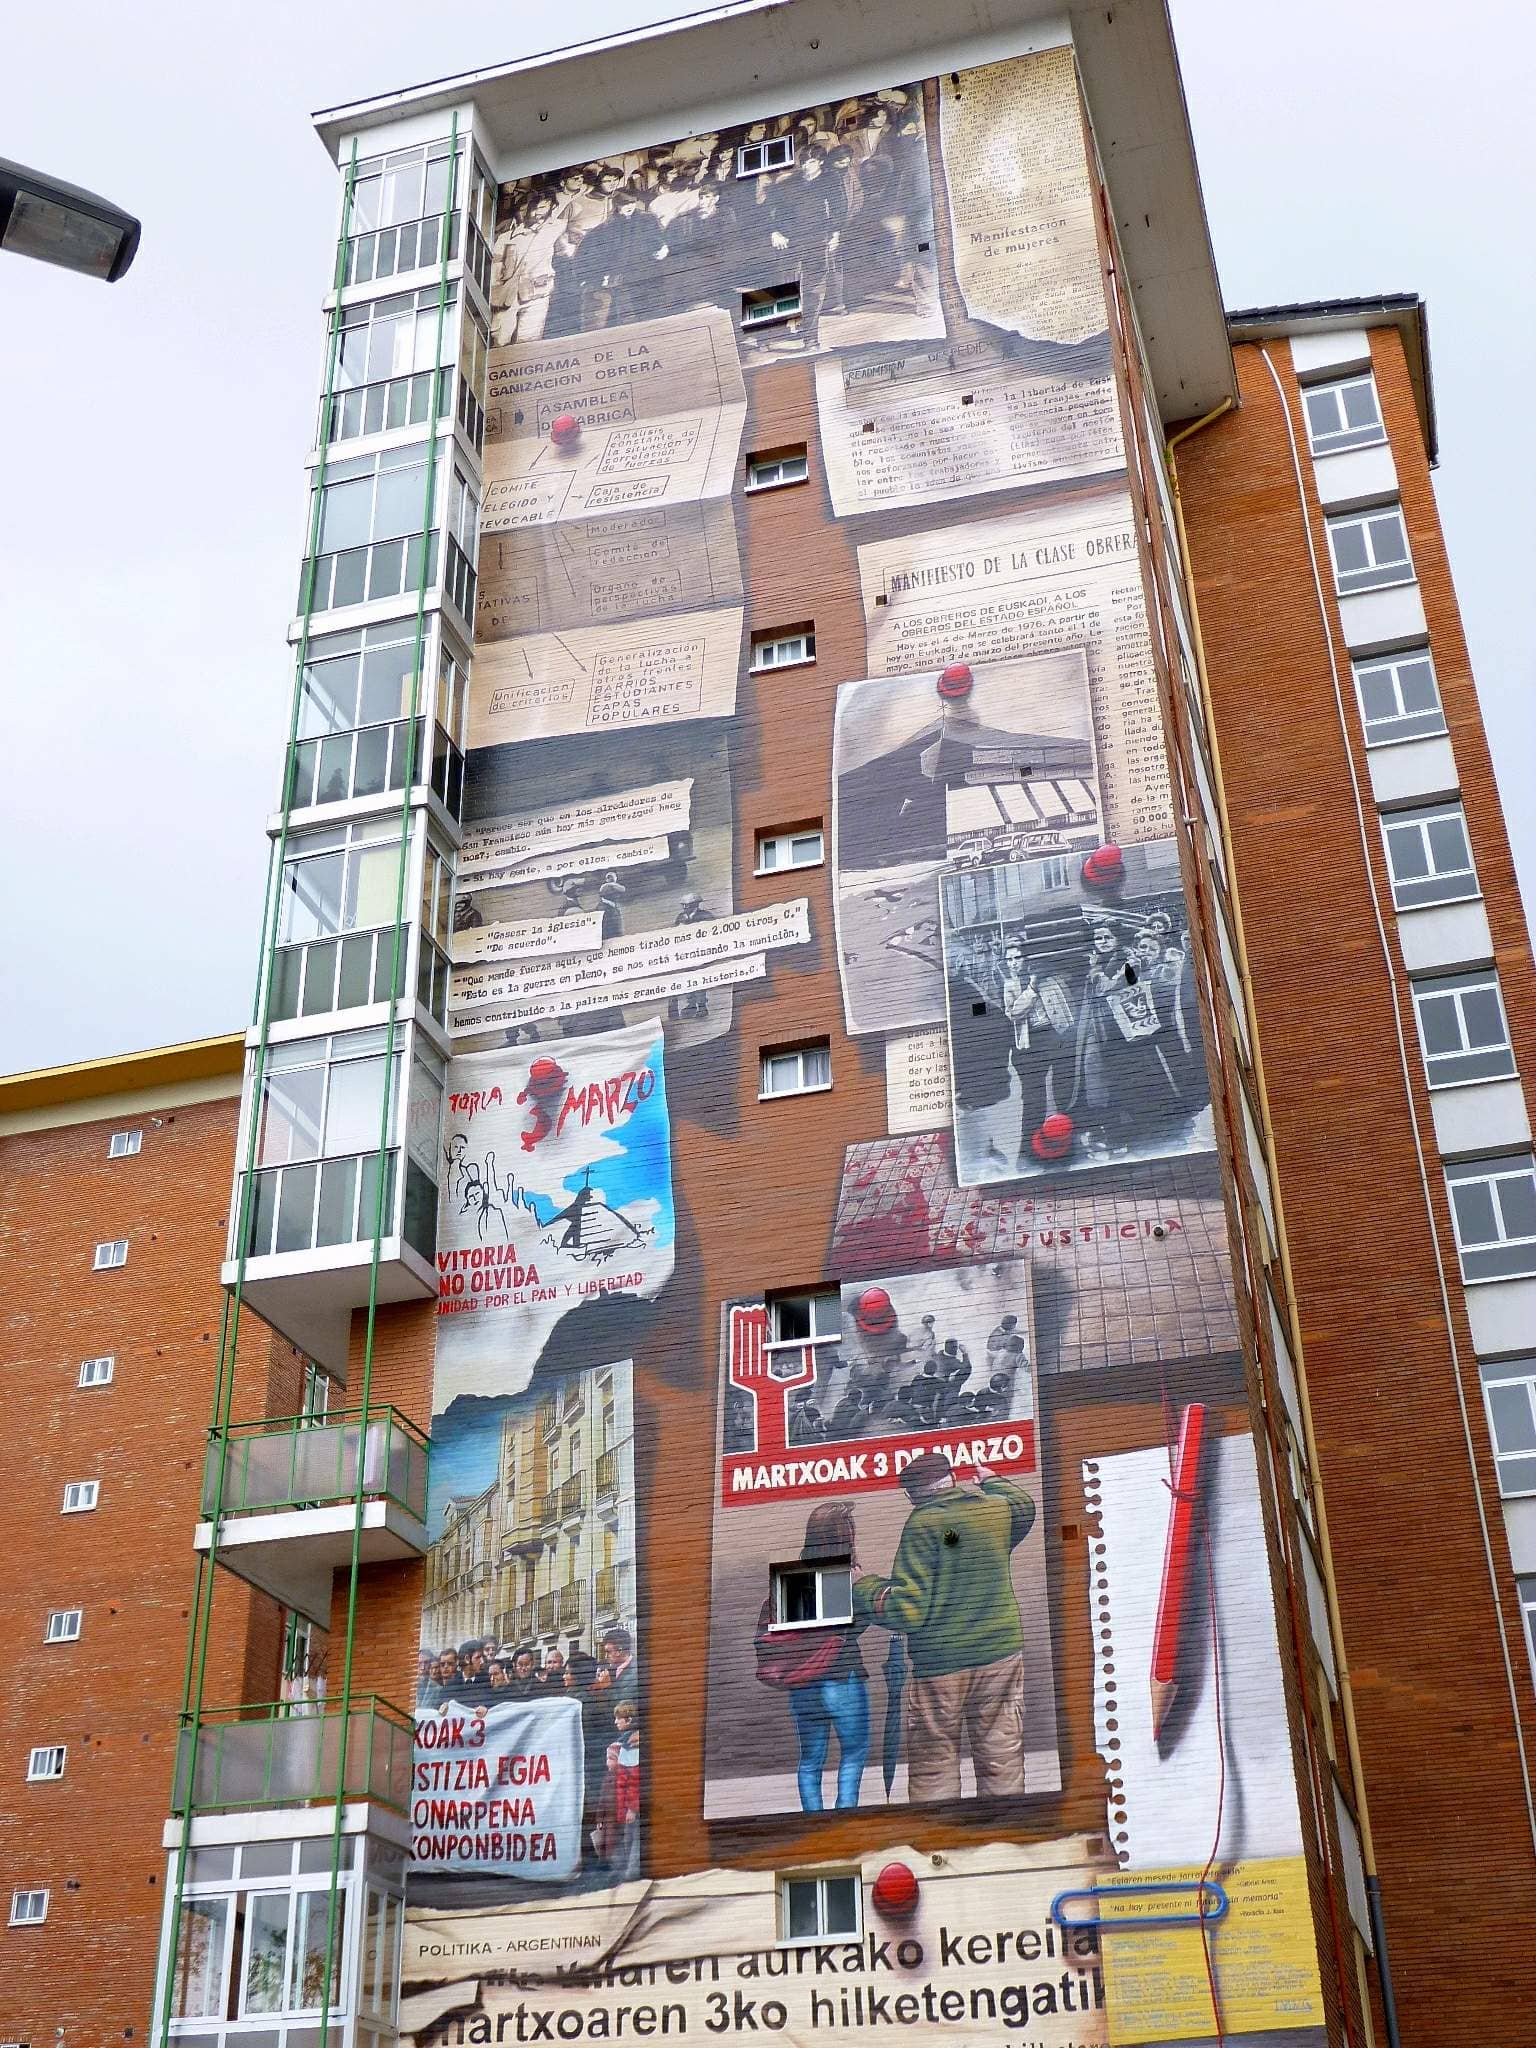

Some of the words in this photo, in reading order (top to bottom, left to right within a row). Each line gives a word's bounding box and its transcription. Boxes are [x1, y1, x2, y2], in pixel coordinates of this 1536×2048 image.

[970, 218, 1066, 245] Manifestación
[984, 245, 1001, 257] de
[1006, 236, 1059, 254] mujeres
[594, 351, 613, 363] DE
[628, 345, 649, 358] LA
[595, 359, 663, 380] OBRERA
[540, 391, 629, 415] ASAMBLEA
[577, 407, 633, 426] ABRICA
[594, 487, 620, 497] Caja
[484, 497, 537, 513] ELEGIDO
[891, 561, 975, 593] MANIFIESTO
[984, 555, 1002, 575] DE
[1011, 551, 1028, 570] LA
[1036, 543, 1076, 566] CLASE
[903, 619, 923, 628] LOS
[925, 609, 977, 625] OBREROS
[980, 606, 995, 616] DE
[1055, 594, 1062, 602] A
[1065, 589, 1087, 600] LOS
[901, 624, 951, 638] OBREROS
[954, 618, 977, 629] DEL
[980, 610, 1024, 625] ESTADO
[1019, 620, 1046, 631] 1976.
[1059, 613, 1086, 625] partir
[600, 644, 699, 666] Generalización
[594, 678, 657, 694] BARRIOS
[594, 681, 694, 704] ESTUDIANTES
[592, 699, 641, 713] CAPAS
[592, 704, 680, 723] POPULARES
[576, 808, 593, 817] los
[660, 792, 673, 800] de
[462, 841, 479, 851] San
[482, 831, 531, 847] Francisco
[556, 860, 575, 871] por
[487, 927, 527, 940] "Gasear
[532, 926, 543, 934] la
[519, 963, 552, 977] fuerza
[586, 952, 604, 963] que
[607, 945, 635, 958] hemos
[639, 936, 670, 951] tirado
[695, 929, 708, 939] de
[711, 921, 741, 936] 2.000
[746, 915, 778, 929] tiros,
[461, 990, 488, 1002] "Esto
[492, 988, 503, 996] es
[508, 984, 519, 993] la
[523, 978, 556, 993] guerra
[559, 975, 571, 984] en
[575, 969, 607, 983] pleno,
[612, 965, 624, 974] se
[627, 960, 644, 971] nos
[675, 944, 729, 962] terminando
[733, 940, 746, 949] la
[454, 1016, 482, 1028] hemos
[485, 1006, 546, 1023] contribuido
[560, 1001, 572, 1010] la
[575, 995, 609, 1010] paliza
[633, 984, 667, 999] grande
[671, 981, 682, 991] de
[687, 979, 699, 988] la
[923, 1076, 946, 1085] todo
[556, 1069, 656, 1137] MARZO
[1017, 1219, 1183, 1249] JUSTICIA
[437, 1243, 517, 1273] VITORIA
[439, 1273, 465, 1297] NO
[470, 1263, 540, 1293] OLVIDA
[483, 1292, 510, 1309] POR
[513, 1290, 528, 1305] EL
[531, 1286, 558, 1303] PAN
[564, 1283, 574, 1297] Y
[578, 1271, 644, 1295] LIBERTAD
[732, 1452, 868, 1492] MARTXOAK
[873, 1451, 889, 1478] 3
[468, 1718, 486, 1748] 3
[411, 1758, 490, 1791] STIZIA
[497, 1754, 552, 1786] EGIA
[414, 1797, 536, 1831] ONARPENA
[419, 1941, 493, 1957] POLITIKA
[505, 1934, 602, 1954] ARGENTINAN
[737, 1932, 924, 1979] aurkako
[940, 1917, 1099, 1967] kereila
[704, 1989, 789, 2034] 3ko
